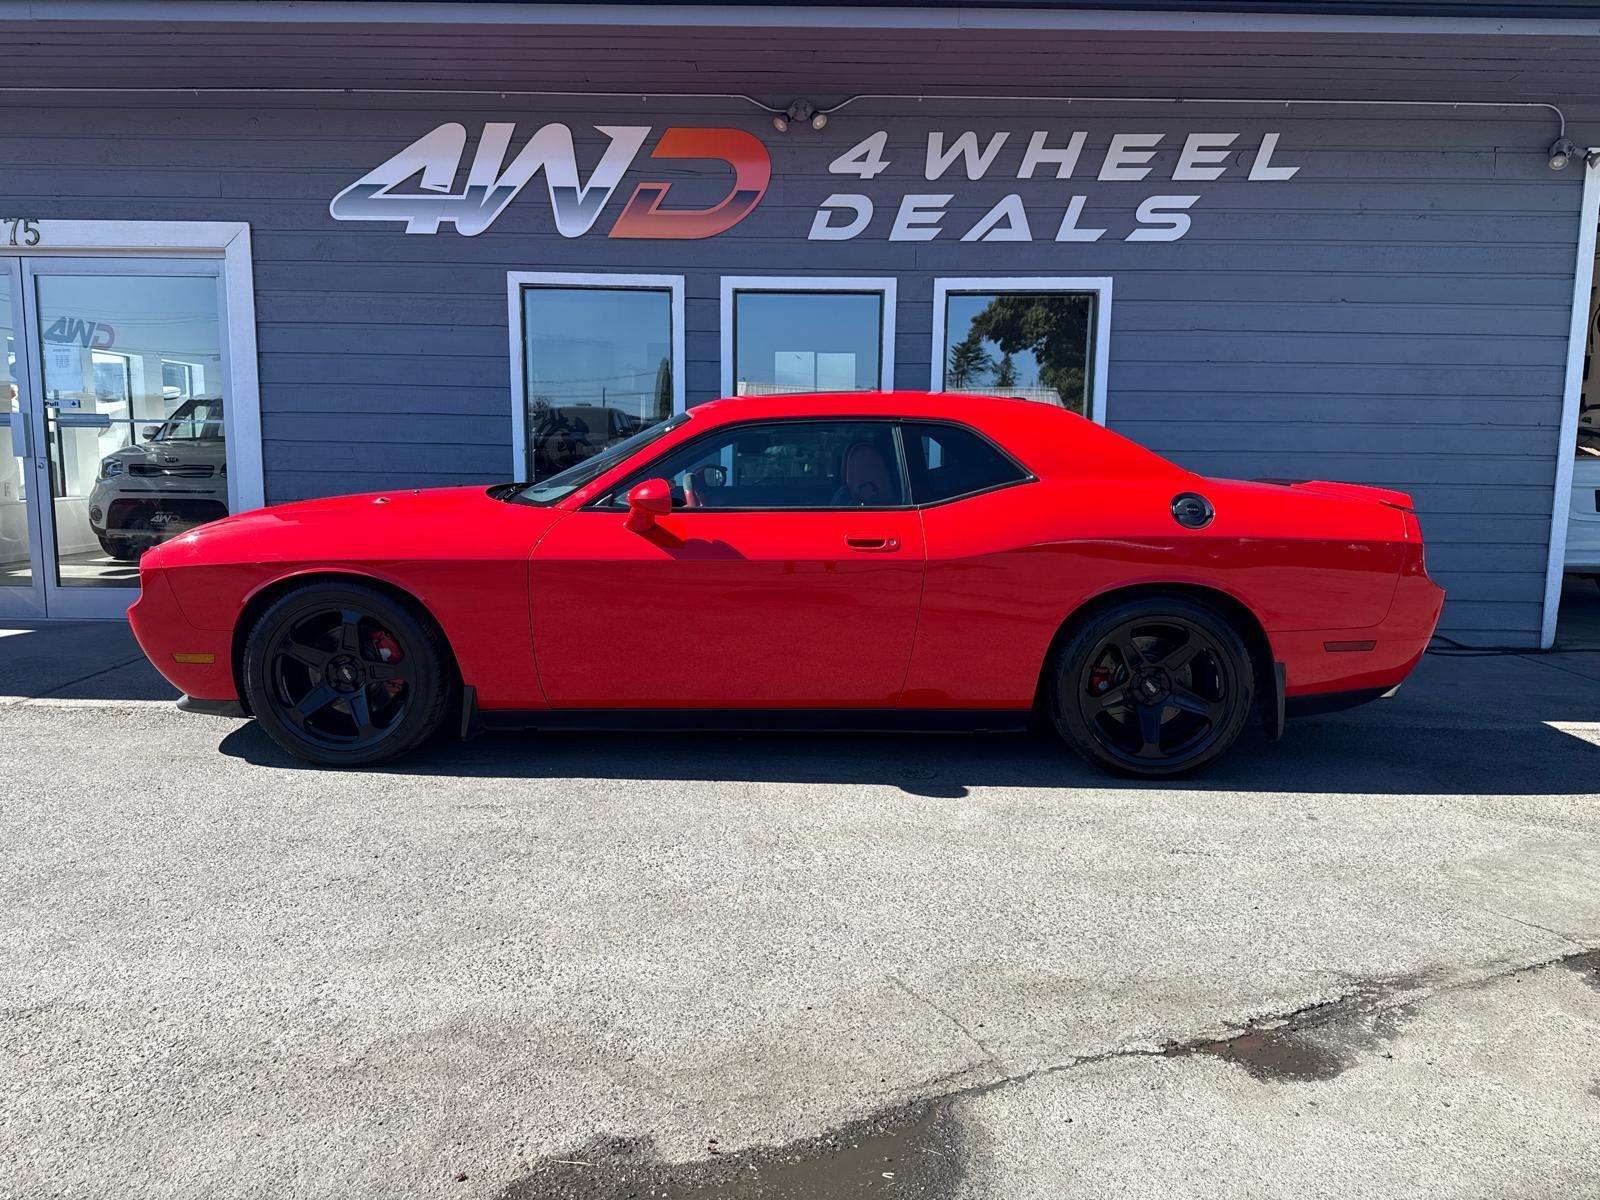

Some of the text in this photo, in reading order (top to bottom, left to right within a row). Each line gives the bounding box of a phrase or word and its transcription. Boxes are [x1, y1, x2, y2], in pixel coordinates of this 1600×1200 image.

[330, 122, 772, 239] 4WD
[828, 130, 1300, 182] 4 WHEEL
[3, 217, 40, 246] 75
[807, 193, 1201, 242] DEALS
